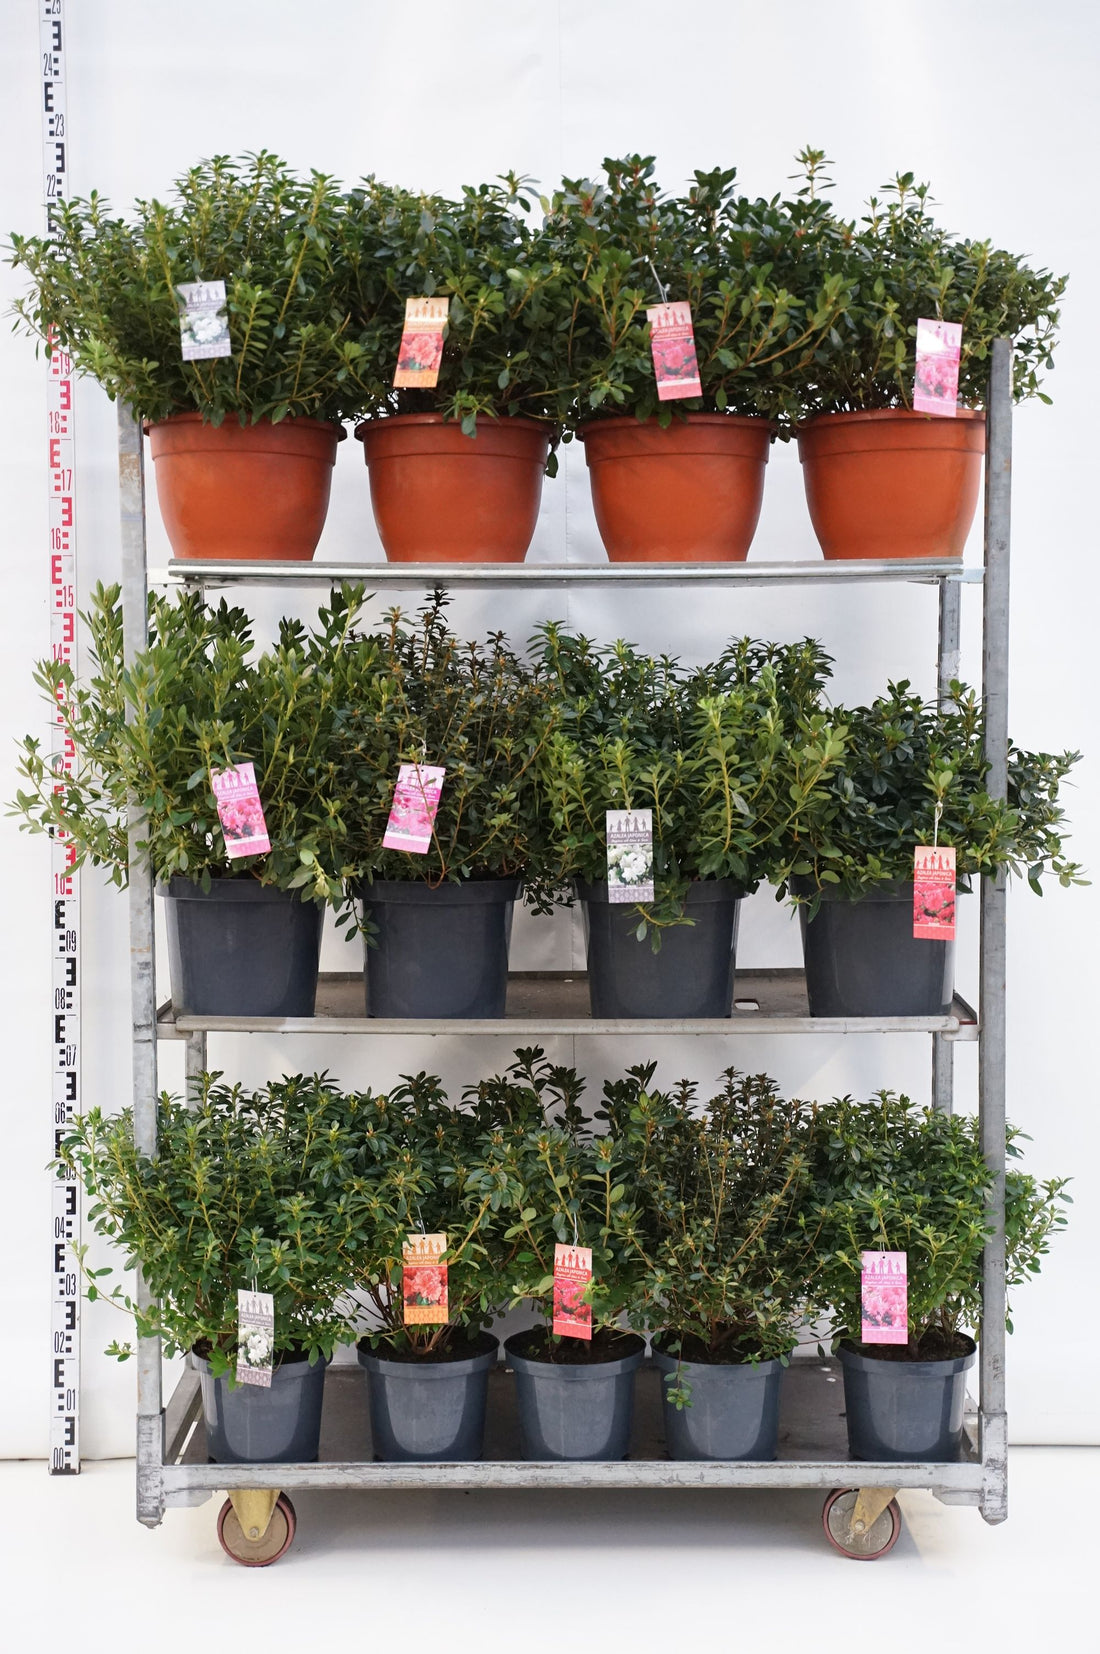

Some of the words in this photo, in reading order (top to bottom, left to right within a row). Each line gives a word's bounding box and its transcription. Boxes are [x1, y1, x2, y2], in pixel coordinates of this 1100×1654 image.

[43, 53, 53, 76] 24
[54, 114, 64, 137] 23
[46, 174, 56, 197] 22
[49, 411, 59, 434] 18
[61, 469, 71, 491] 17
[51, 527, 61, 550] 16
[62, 585, 73, 608] 15
[627, 832, 650, 840] JAPONICA
[55, 873, 65, 895] 10
[65, 930, 76, 952] 09
[55, 988, 65, 1009] 08
[65, 1044, 76, 1066] 07
[55, 1102, 65, 1124] 06
[54, 1216, 65, 1238] 04
[65, 1273, 76, 1295] 03
[54, 1331, 64, 1353] 02
[66, 1388, 76, 1410] 01
[53, 1447, 64, 1470] 00
